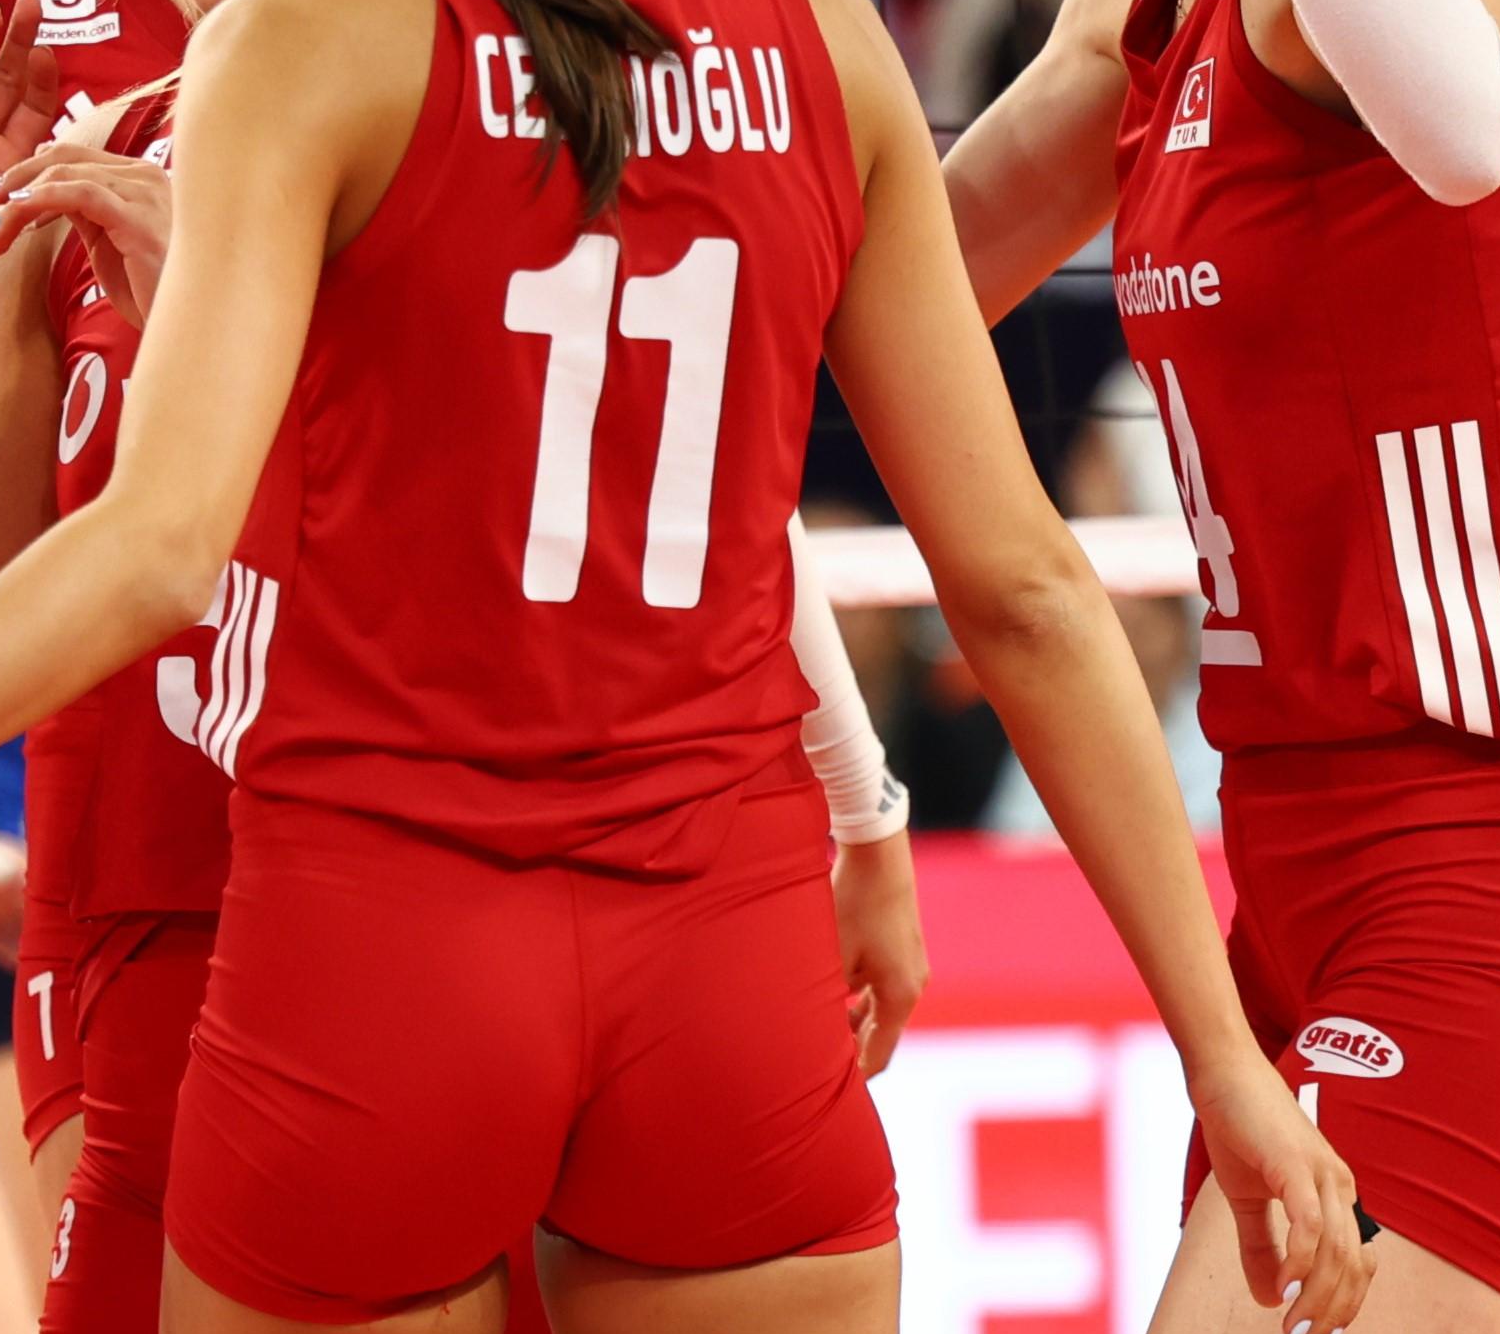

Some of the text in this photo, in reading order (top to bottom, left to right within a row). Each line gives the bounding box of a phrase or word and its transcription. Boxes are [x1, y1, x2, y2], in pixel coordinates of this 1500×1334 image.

[39, 22, 116, 39] binden.com
[1174, 127, 1198, 146] TUR
[1113, 251, 1222, 317] vodafone
[503, 232, 740, 609] 11
[1300, 1025, 1394, 1068] gratis
